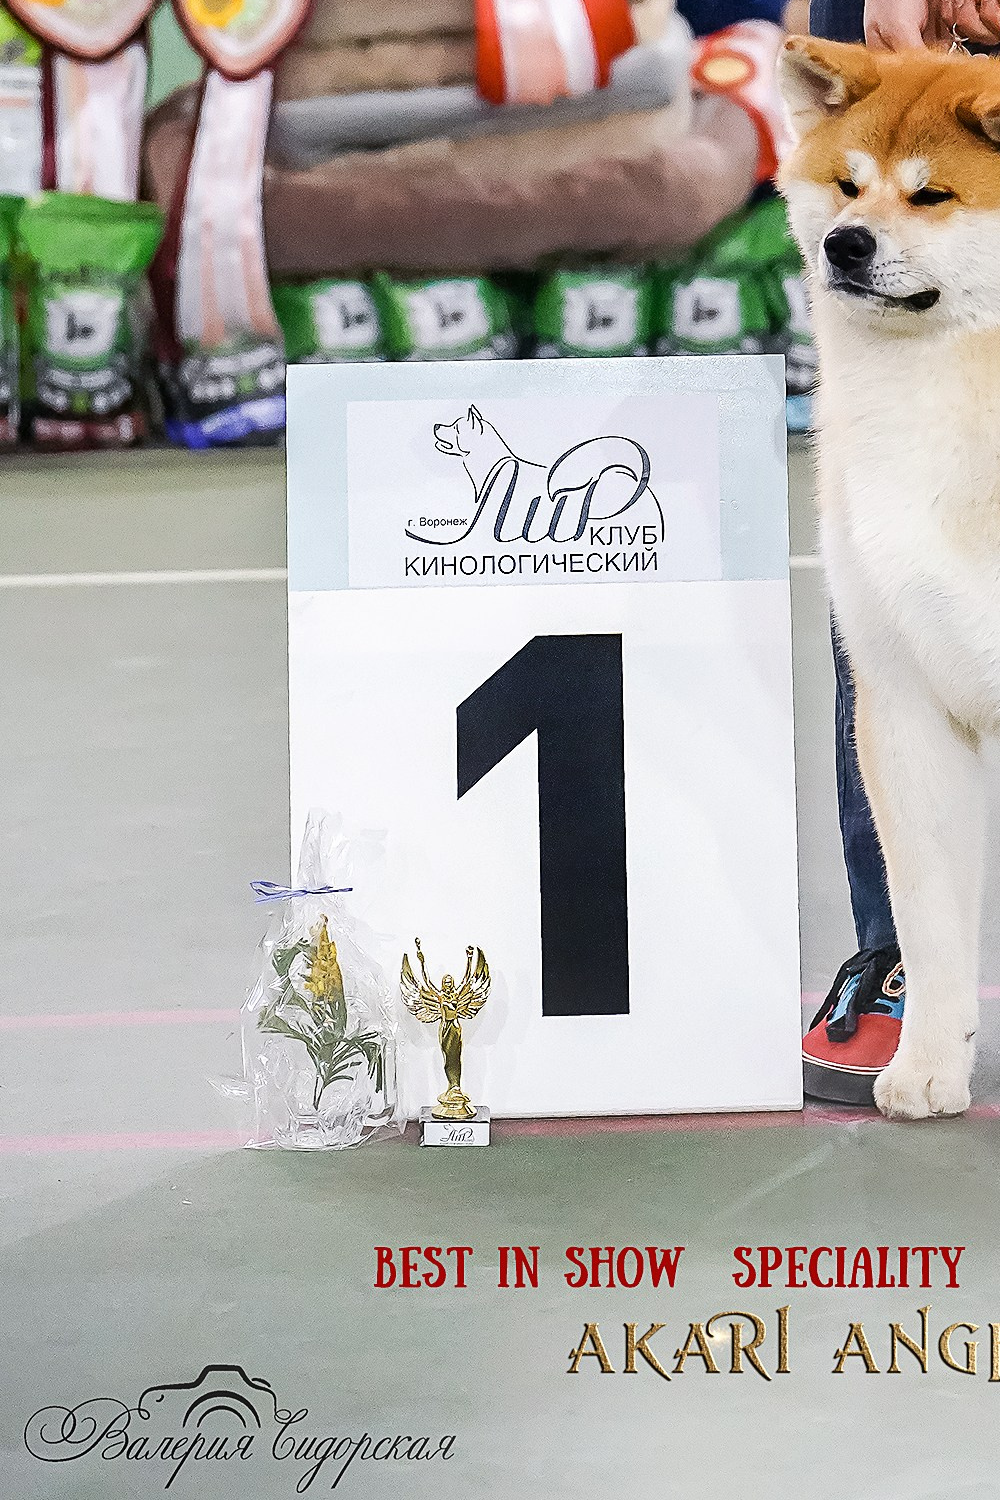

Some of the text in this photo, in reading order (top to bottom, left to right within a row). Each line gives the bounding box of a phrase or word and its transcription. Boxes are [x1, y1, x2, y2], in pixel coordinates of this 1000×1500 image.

[419, 516, 469, 528] Воронеж
[590, 525, 658, 546] КЛУБ
[404, 547, 659, 577] КИНОЛОГИЧЕСКИЙ
[456, 632, 631, 1017] 1
